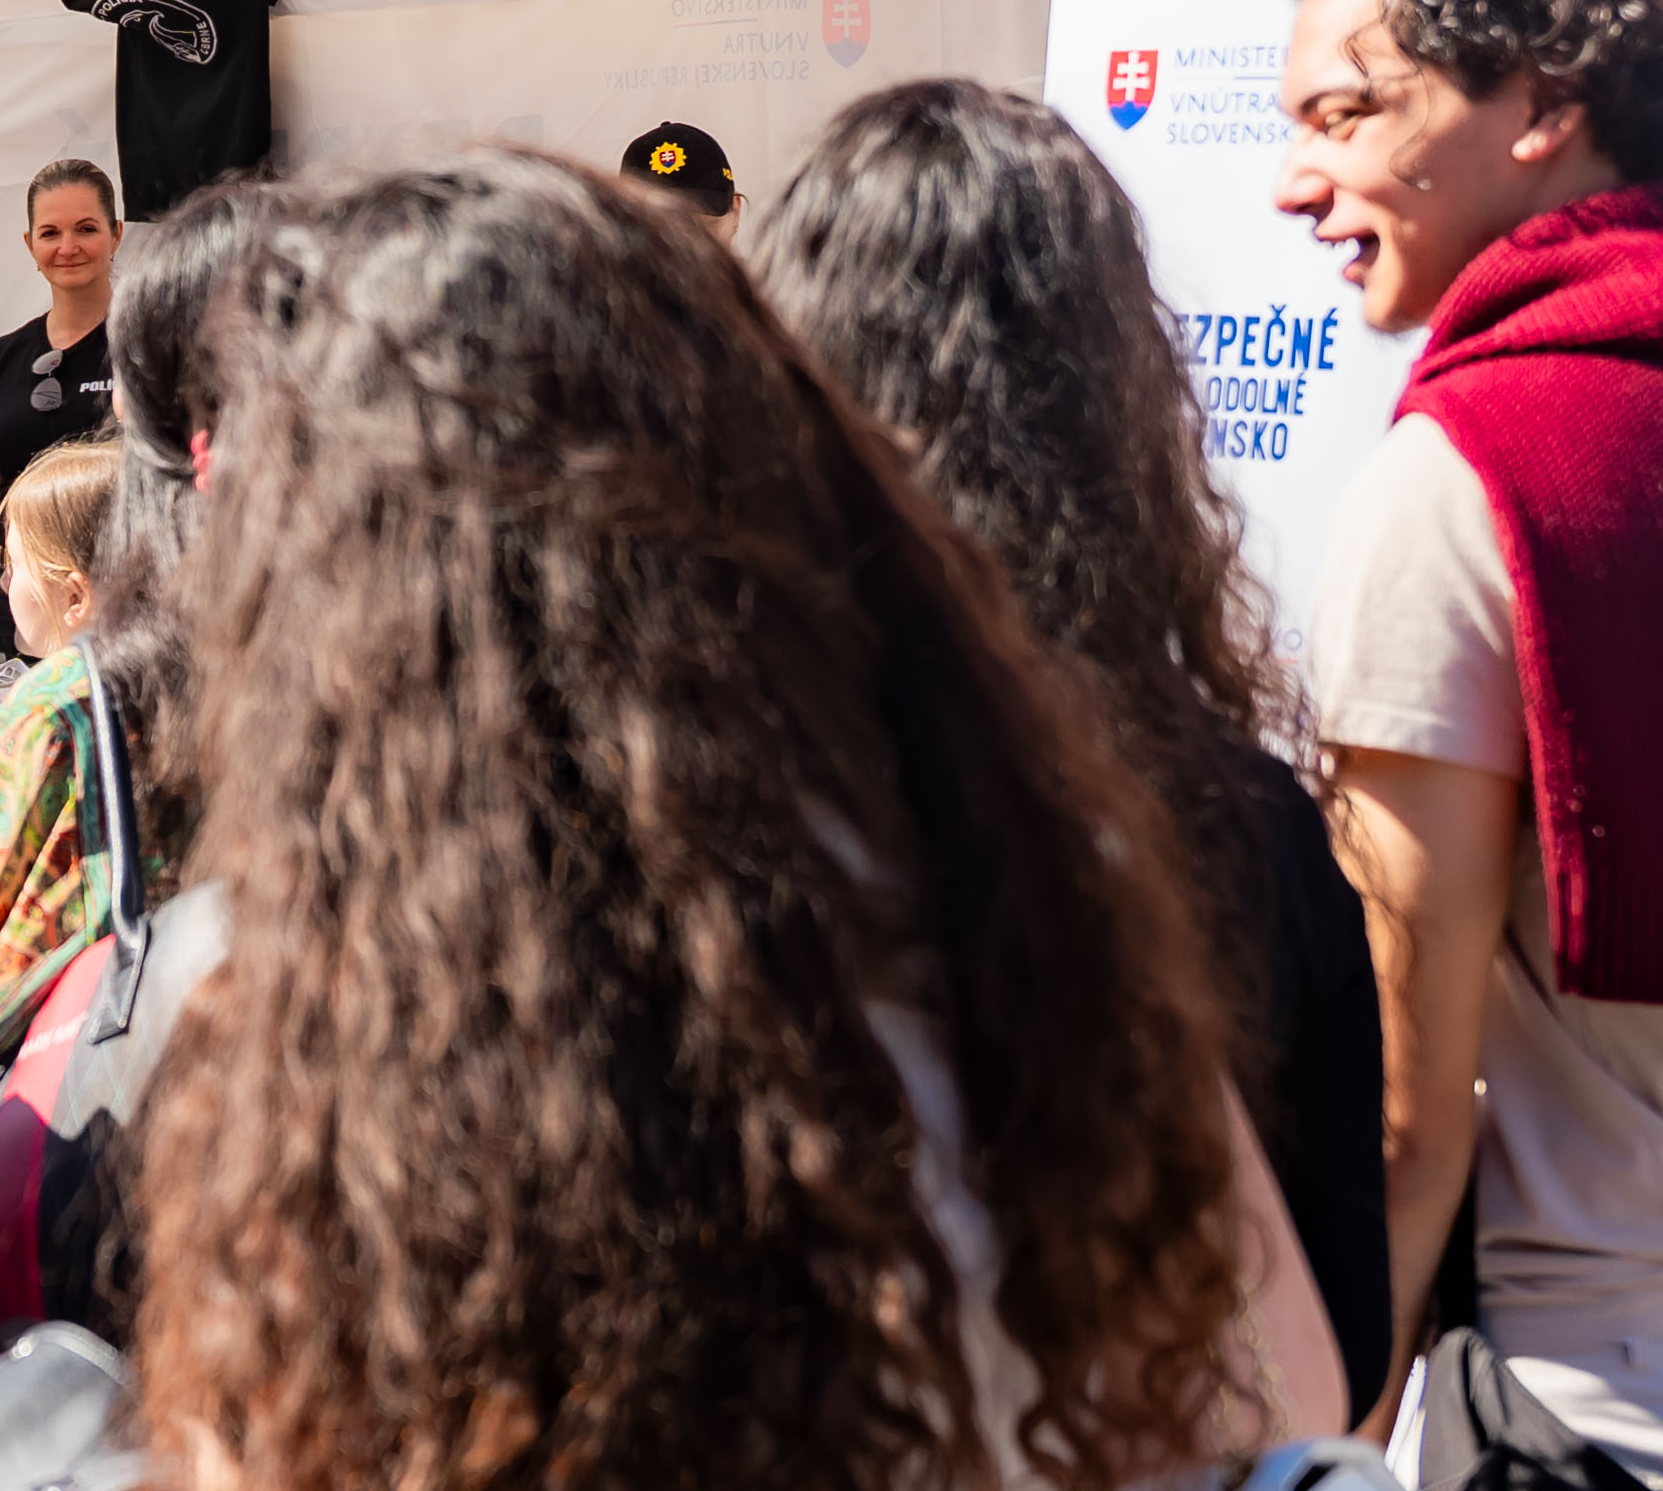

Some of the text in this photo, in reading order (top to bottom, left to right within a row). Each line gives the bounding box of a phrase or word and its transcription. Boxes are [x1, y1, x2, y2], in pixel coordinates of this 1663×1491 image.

[1166, 122, 1294, 147] SLOVENSK
[1178, 303, 1340, 371] ZPEČNÉ
[1207, 371, 1308, 416] ODOLNÉ
